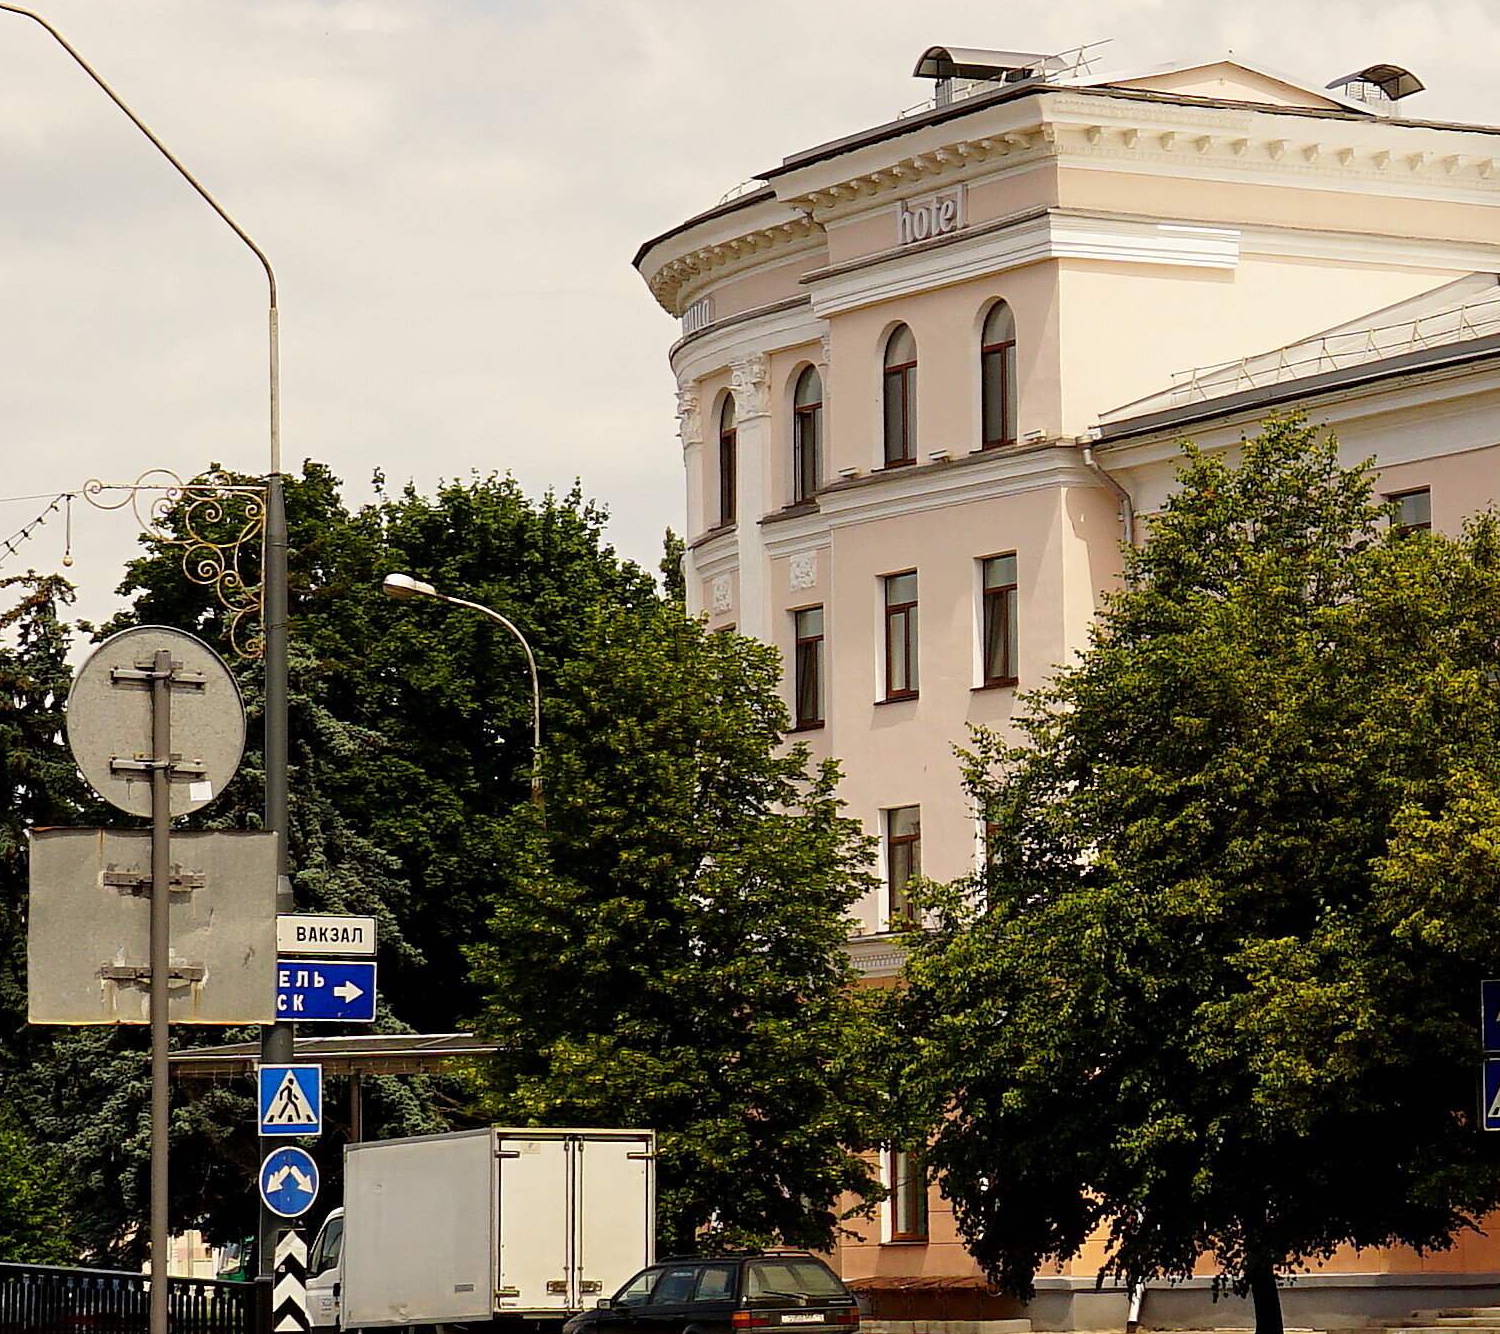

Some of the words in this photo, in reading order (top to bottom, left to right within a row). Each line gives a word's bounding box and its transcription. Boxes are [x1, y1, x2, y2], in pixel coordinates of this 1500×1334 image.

[897, 183, 965, 244] hotel
[296, 926, 363, 943] ВАКЗАЛ
[279, 970, 325, 988] ЕЛЬ
[277, 994, 304, 1011] СК
